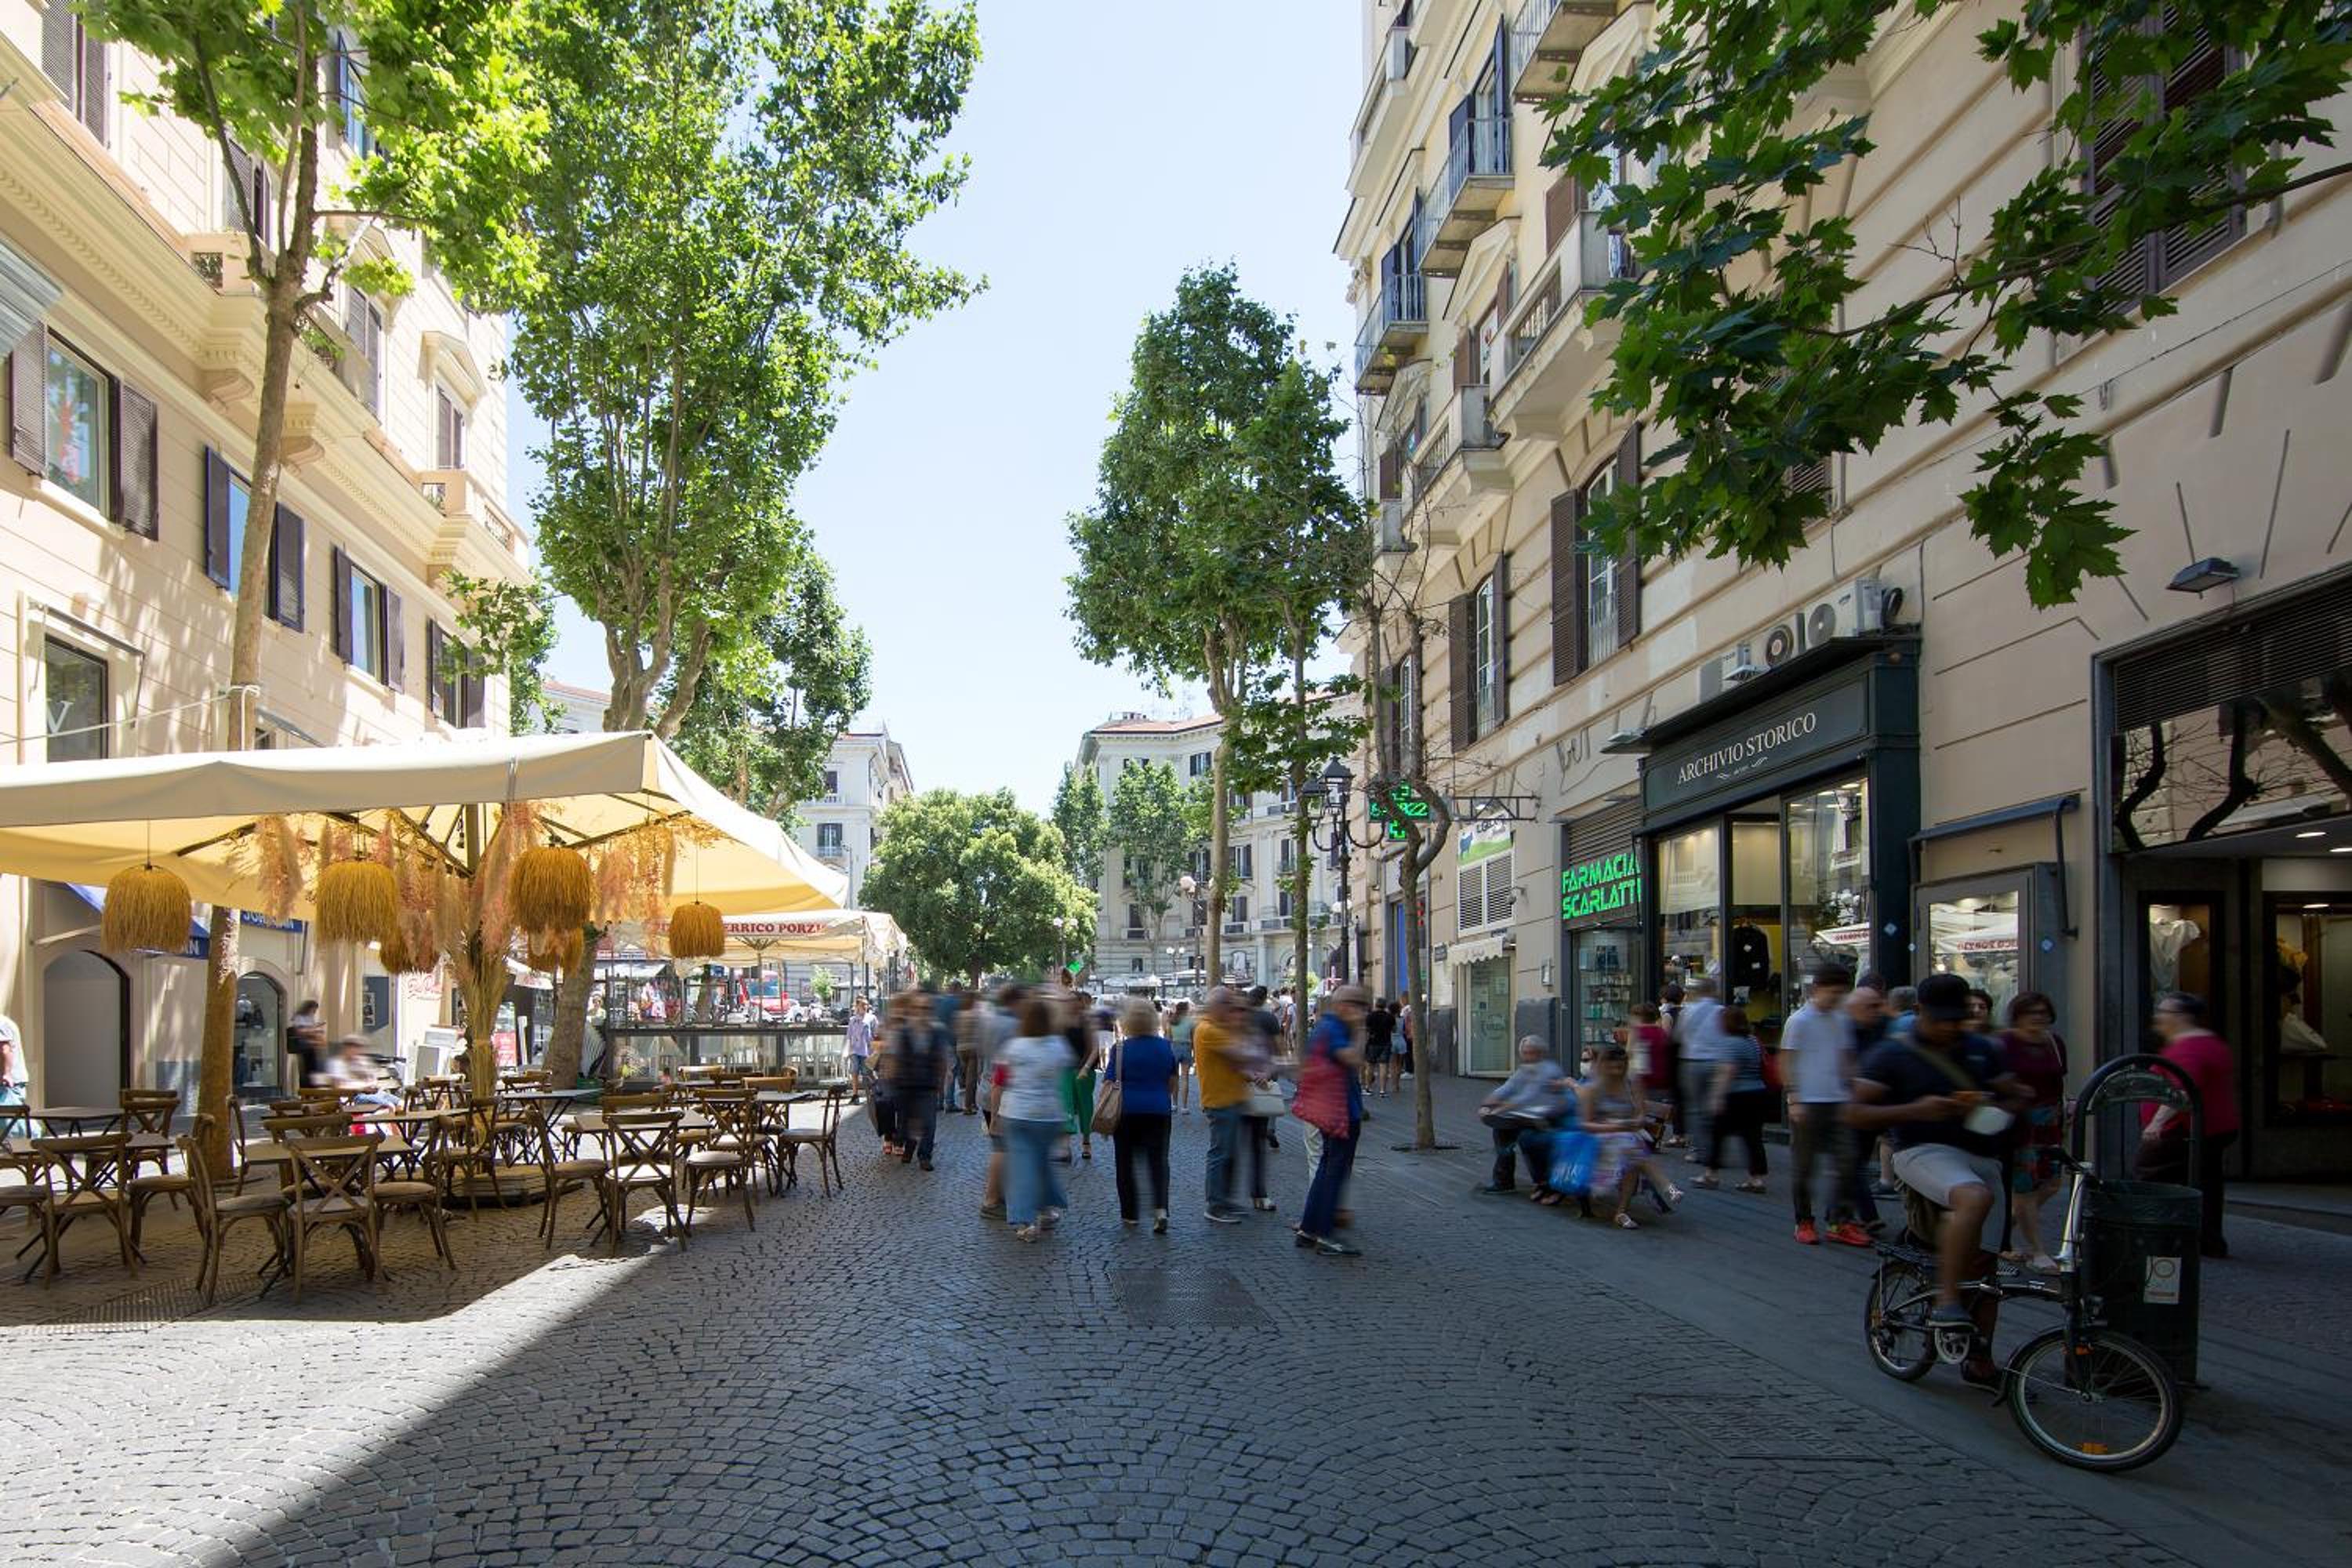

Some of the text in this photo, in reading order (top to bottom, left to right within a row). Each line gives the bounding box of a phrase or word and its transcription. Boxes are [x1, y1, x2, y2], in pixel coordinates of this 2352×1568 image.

[1678, 713, 1817, 784] ARCHIVIO STORICO
[1563, 853, 1640, 894] FARMACIA
[1563, 878, 1641, 919] SCARLATTI
